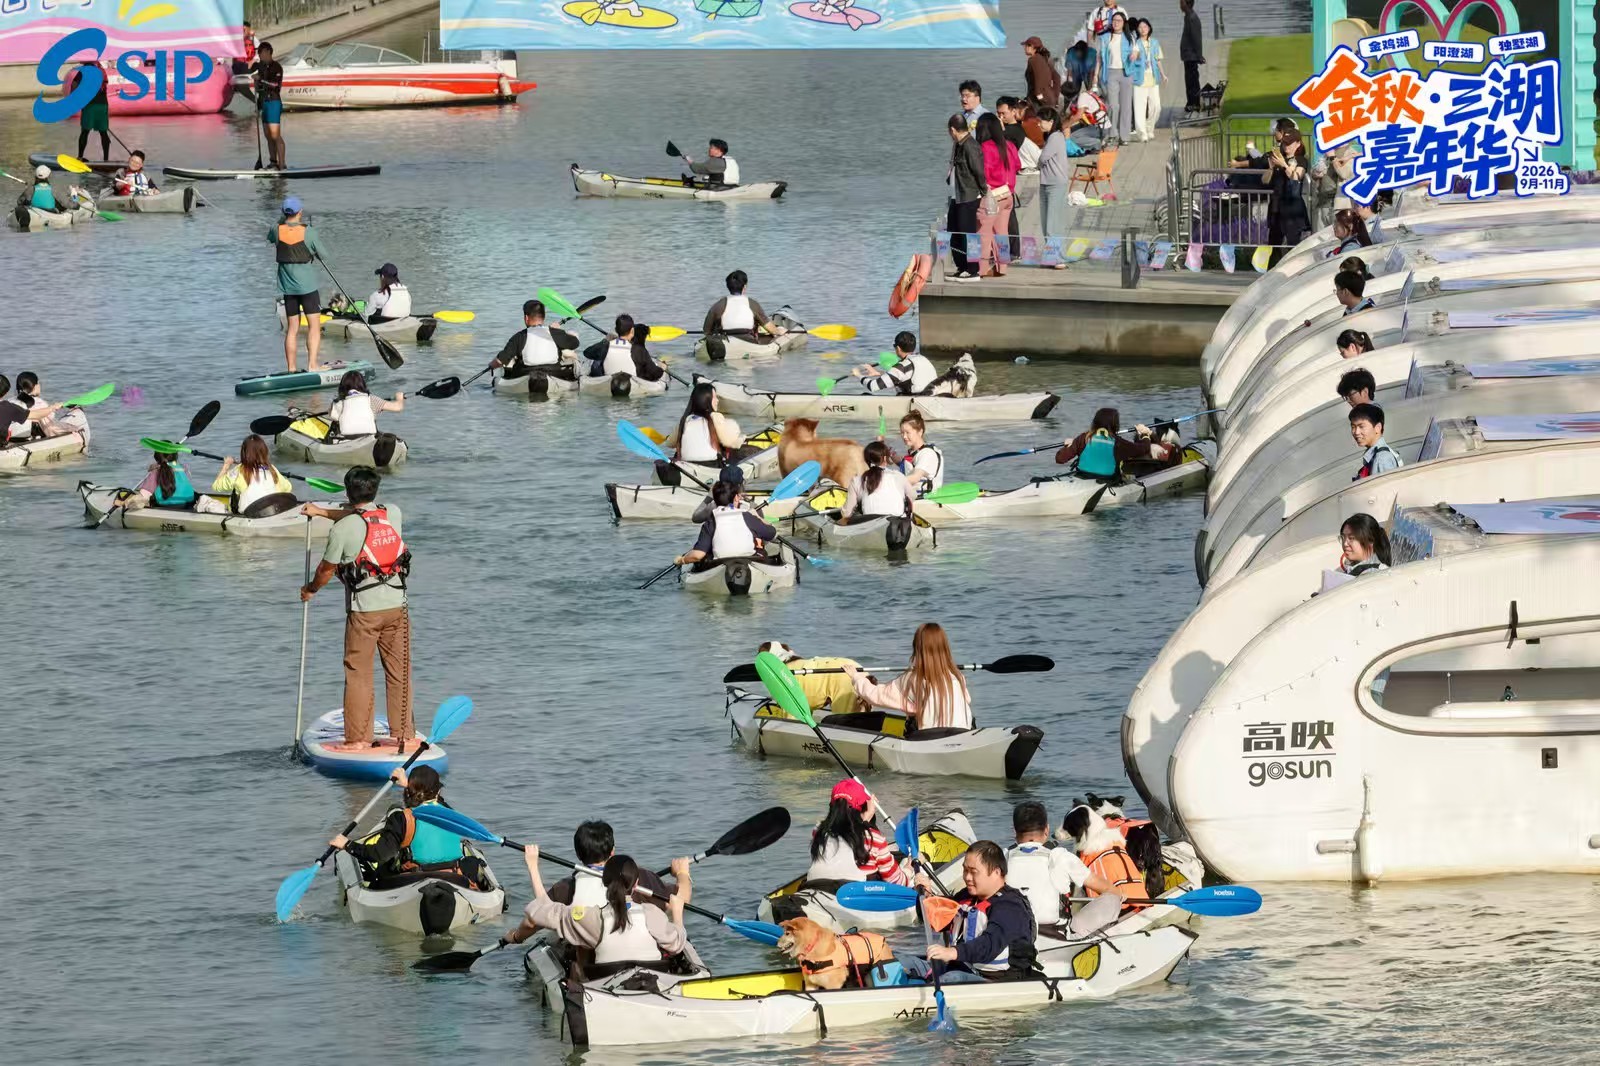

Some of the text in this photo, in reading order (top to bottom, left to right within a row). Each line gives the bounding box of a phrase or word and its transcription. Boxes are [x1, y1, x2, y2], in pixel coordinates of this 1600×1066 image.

[371, 535, 397, 547] STAFF
[1243, 720, 1335, 752] 高映
[1248, 759, 1332, 787] gosun
